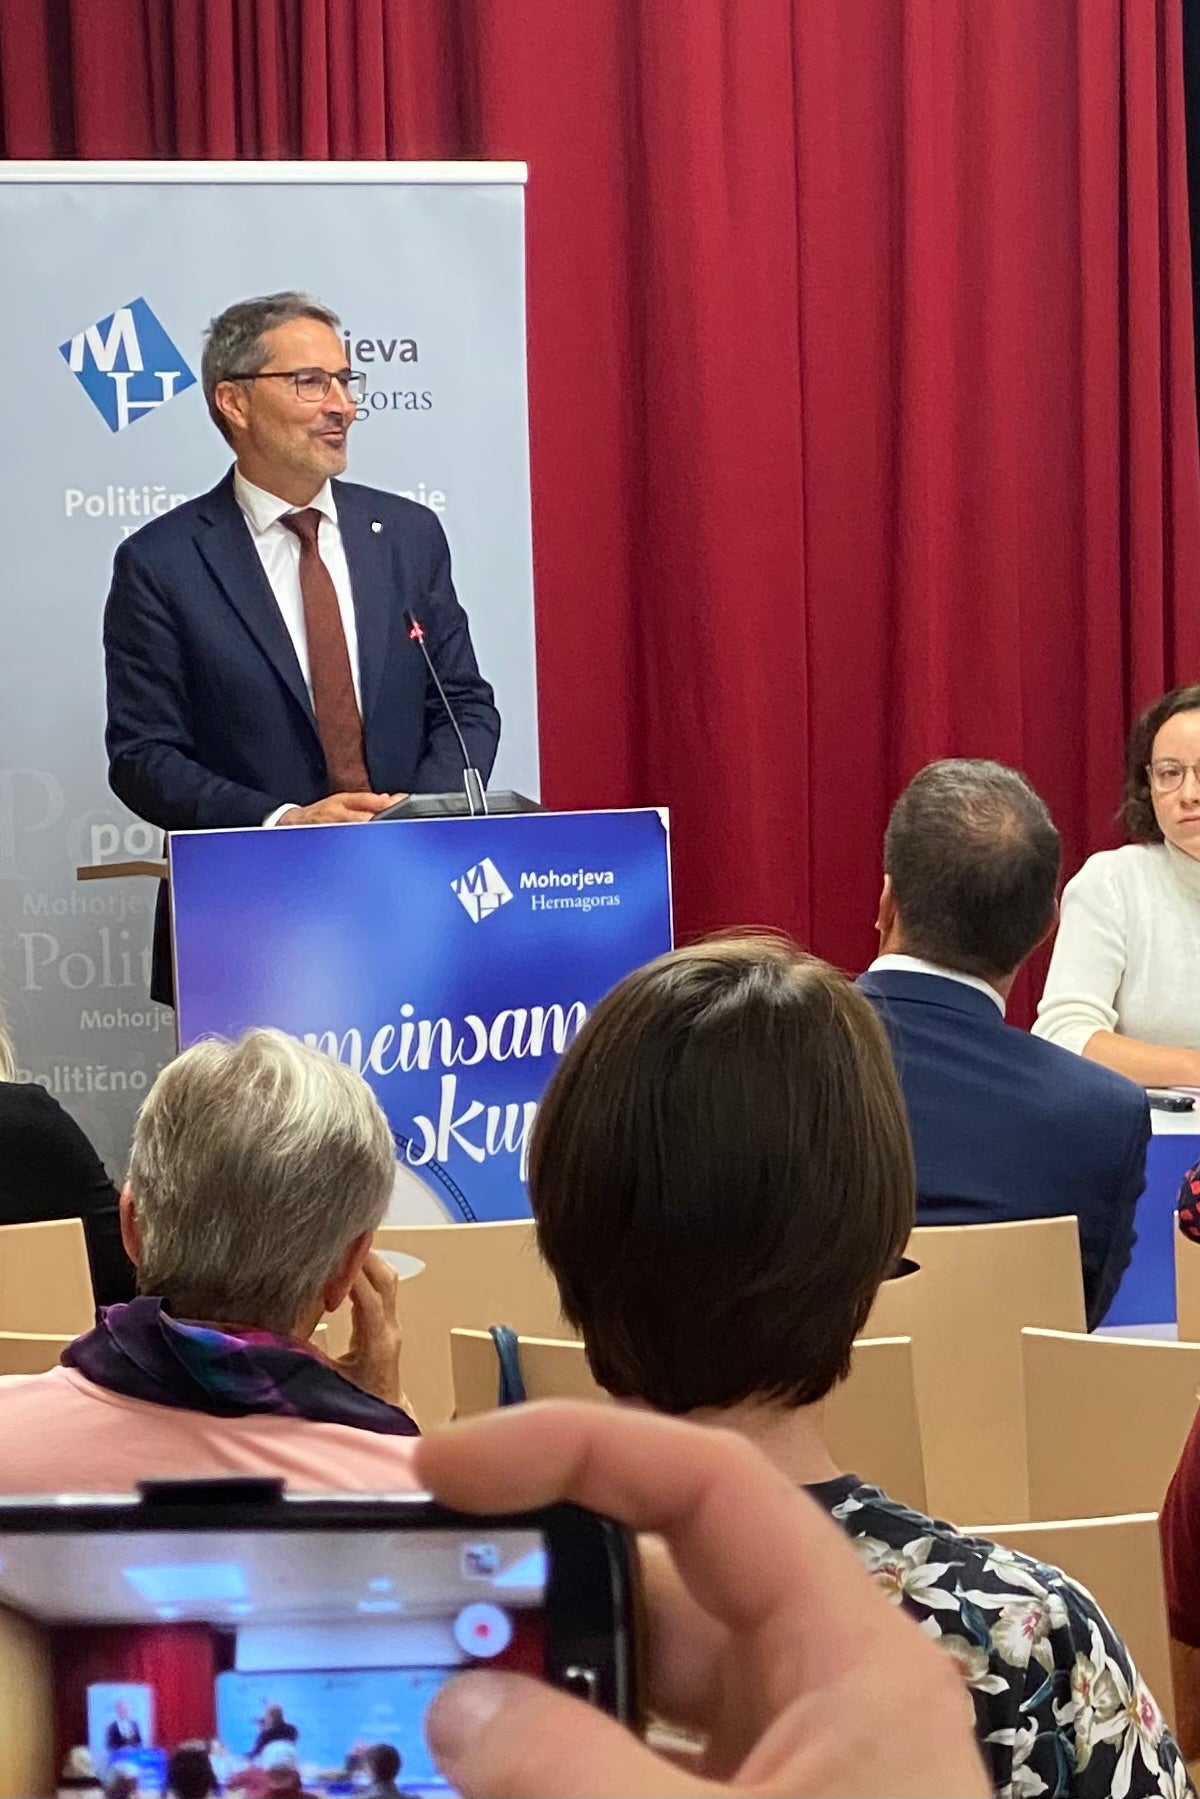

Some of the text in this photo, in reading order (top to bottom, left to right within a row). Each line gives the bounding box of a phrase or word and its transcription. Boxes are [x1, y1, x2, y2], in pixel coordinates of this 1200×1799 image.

[354, 390, 433, 421] goras
[519, 868, 615, 891] Mohorjeva
[531, 894, 621, 913] Hermagoras
[18, 927, 152, 990] Polit
[80, 1006, 173, 1032] Mohorje
